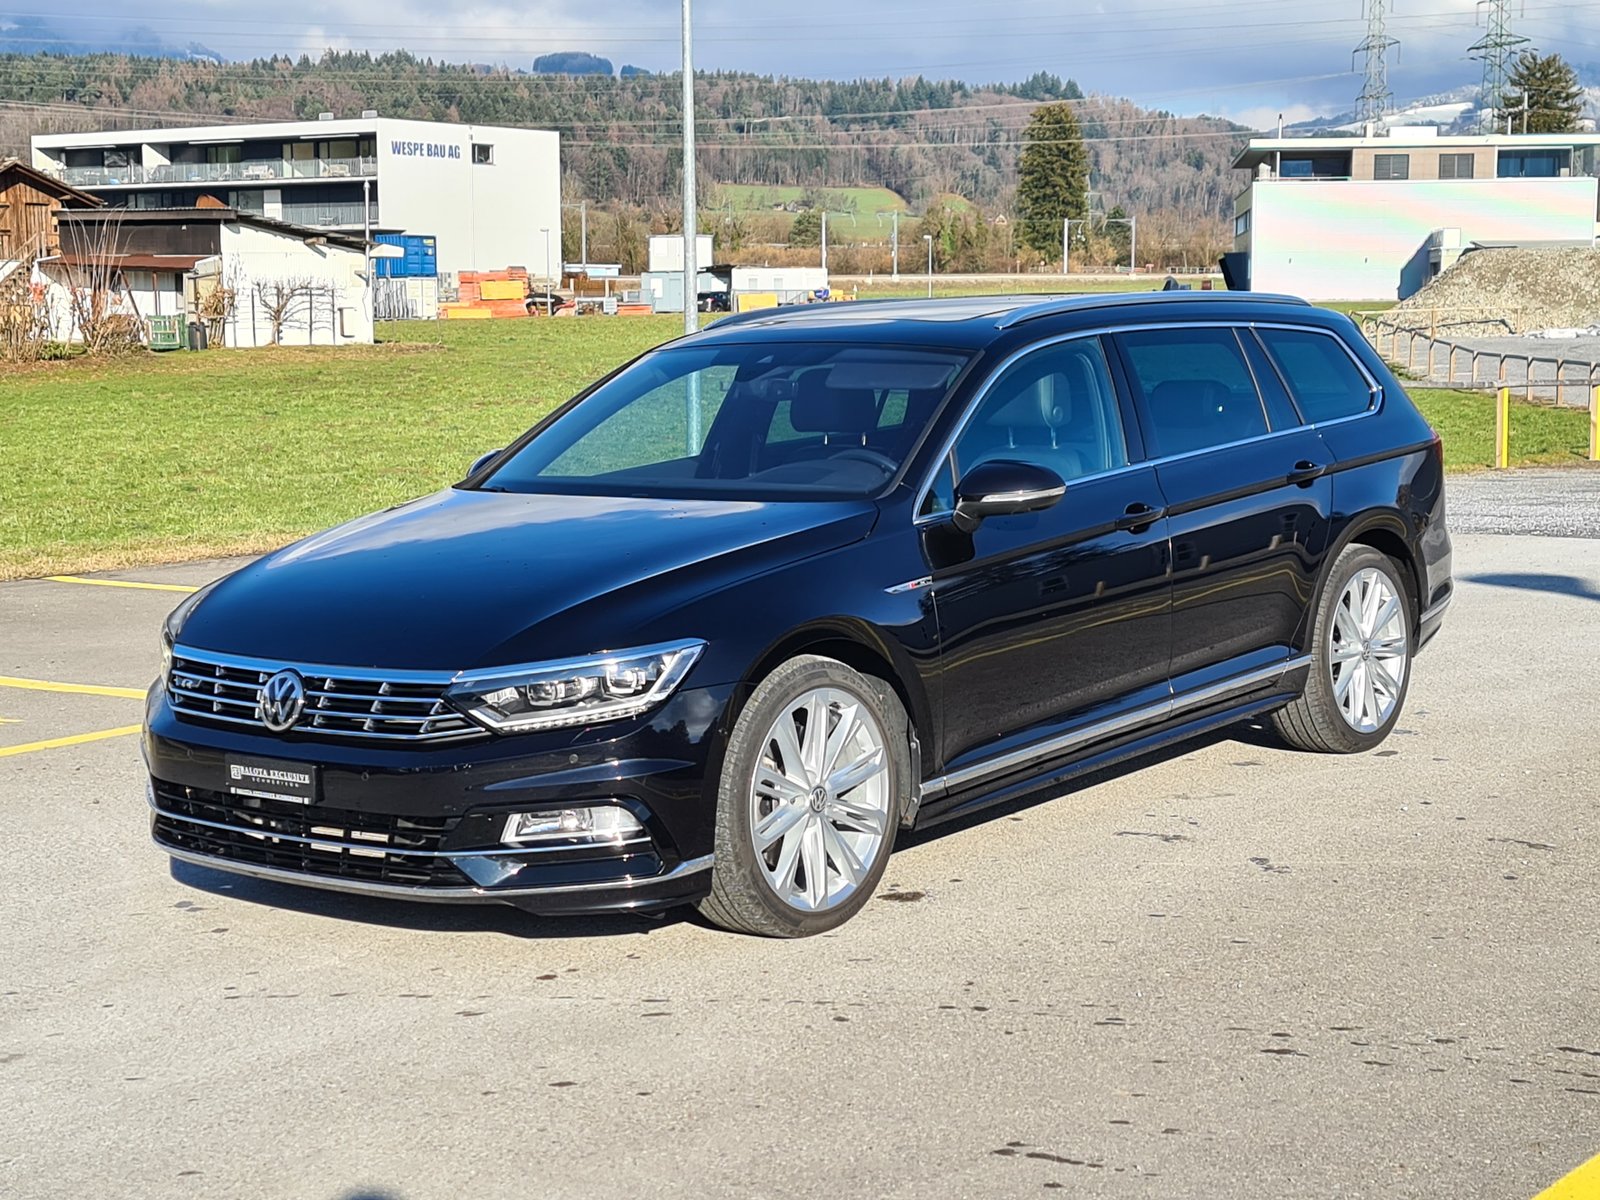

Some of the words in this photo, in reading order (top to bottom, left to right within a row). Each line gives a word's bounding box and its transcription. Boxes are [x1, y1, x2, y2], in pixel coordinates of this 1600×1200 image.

[391, 141, 424, 156] WESPE
[427, 144, 446, 158] BAU
[448, 145, 461, 159] AG
[269, 769, 310, 783] EXCLUSIVE
